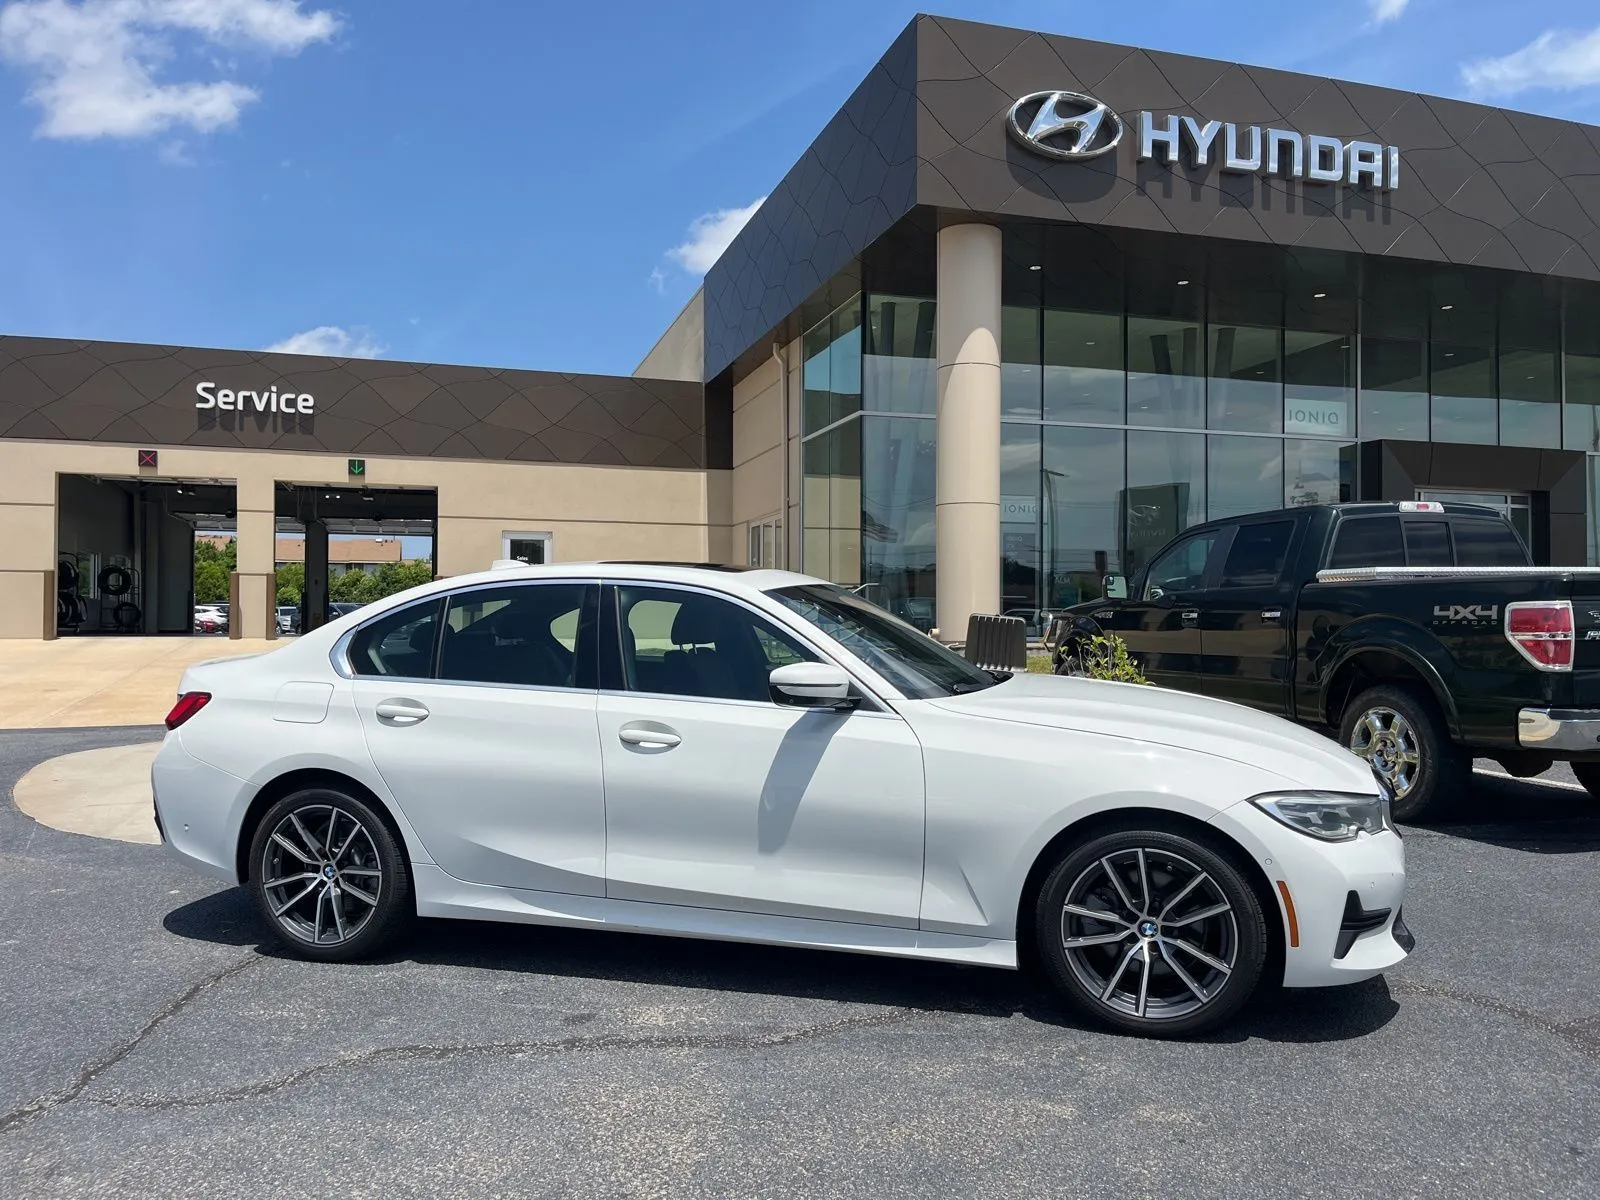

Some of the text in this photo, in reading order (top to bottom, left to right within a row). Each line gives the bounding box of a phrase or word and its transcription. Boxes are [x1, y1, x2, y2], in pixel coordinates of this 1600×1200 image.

[1137, 110, 1399, 190] HYUNDAI
[195, 381, 315, 414] Service
[1289, 409, 1339, 425] IONIQ
[1433, 604, 1499, 620] 4X4
